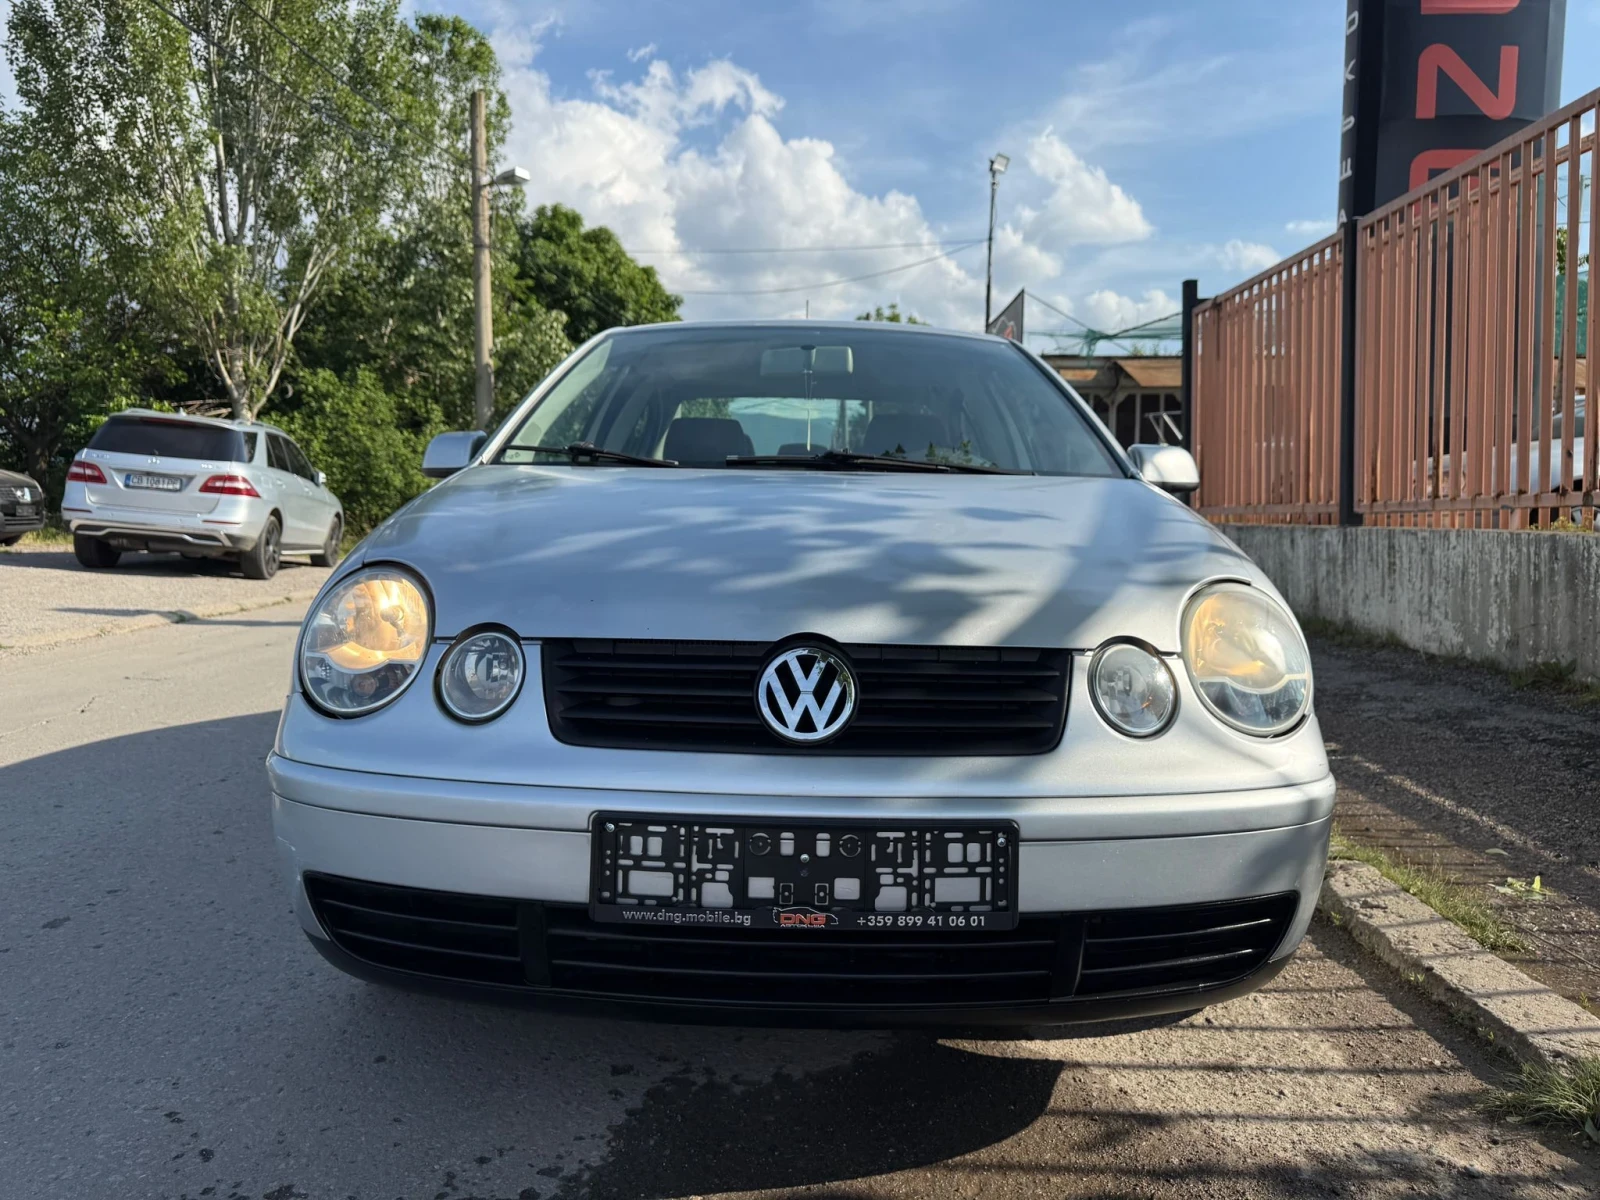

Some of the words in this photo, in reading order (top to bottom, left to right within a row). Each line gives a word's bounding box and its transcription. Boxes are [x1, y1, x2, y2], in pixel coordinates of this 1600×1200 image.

[760, 648, 854, 739] VW
[622, 908, 751, 926] www.dng.mobile.bg
[780, 913, 826, 925] DNG
[857, 915, 893, 927] +359
[897, 915, 923, 927] 899
[927, 915, 943, 927] 41
[948, 915, 966, 927] 06
[970, 915, 985, 927] 01
